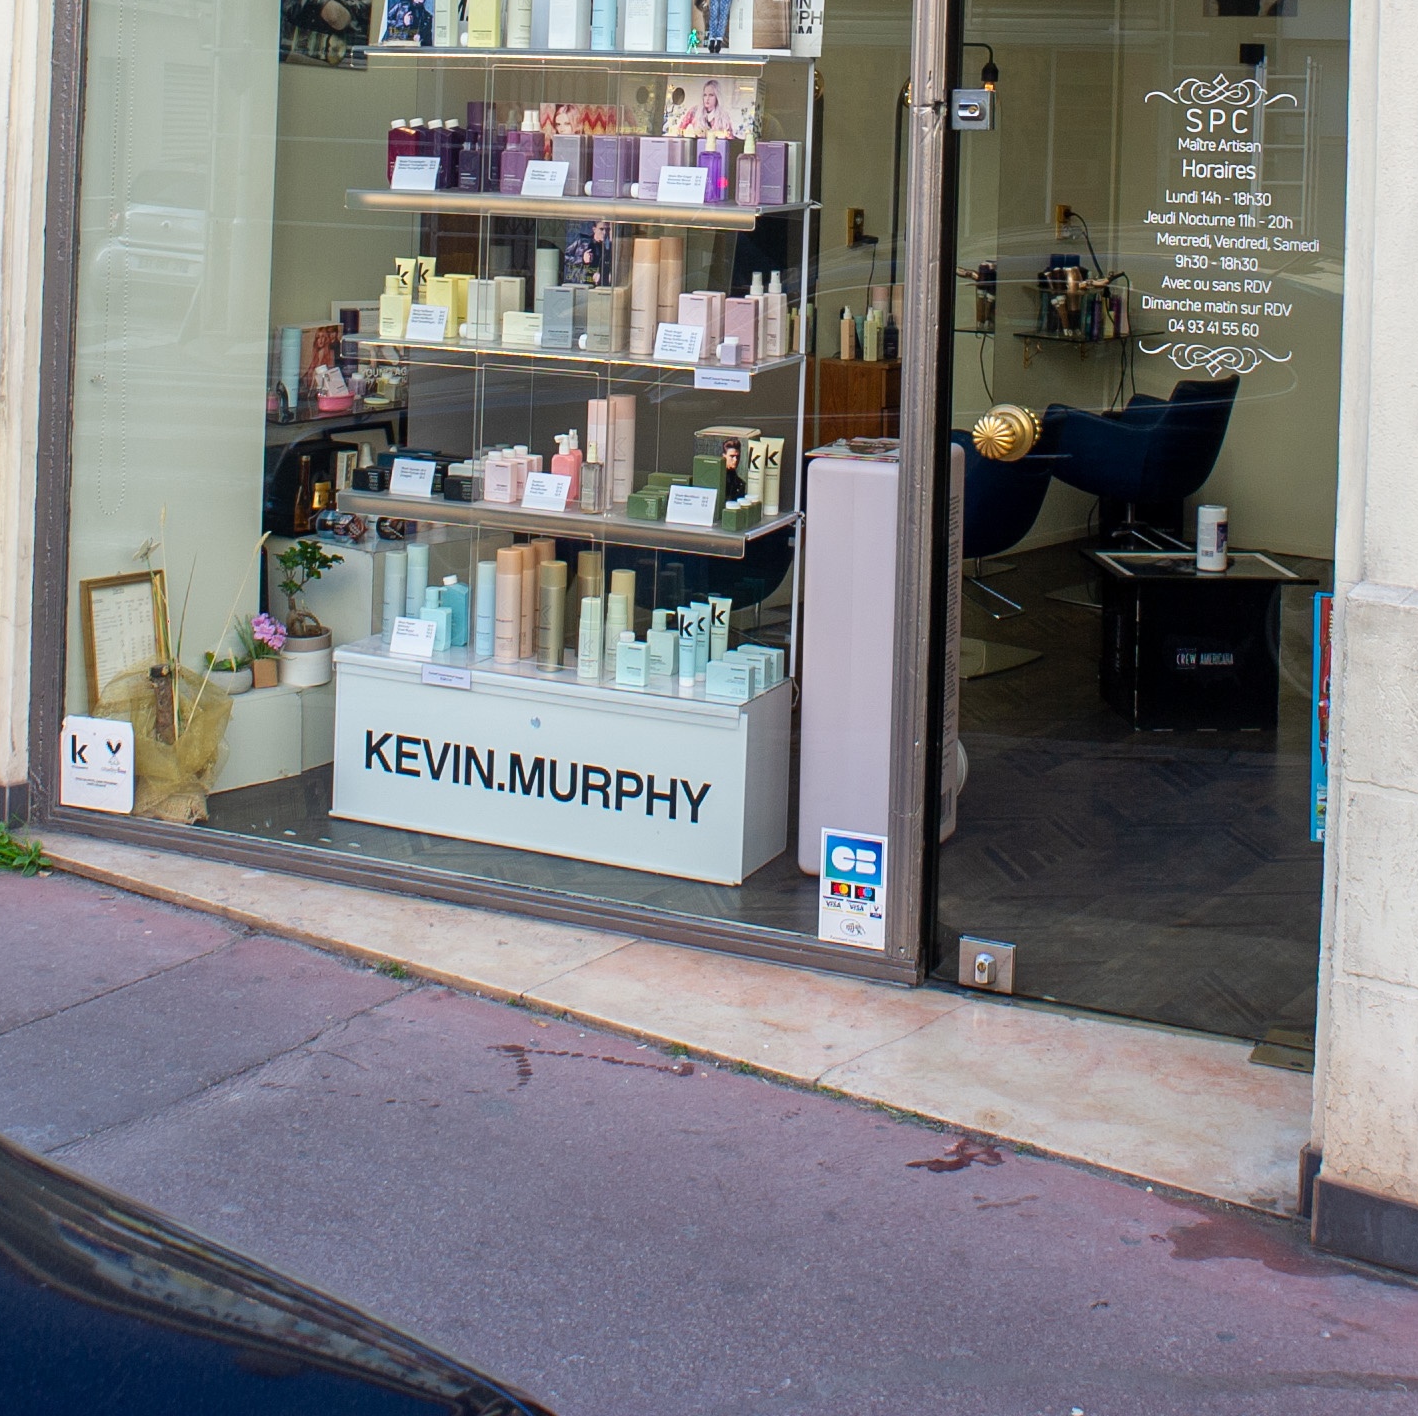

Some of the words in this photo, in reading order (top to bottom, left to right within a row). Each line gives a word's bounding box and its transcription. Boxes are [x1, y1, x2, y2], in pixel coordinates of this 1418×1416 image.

[1186, 108, 1248, 134] SPC
[1178, 137, 1216, 151] Maître
[1218, 139, 1261, 153] Artisan
[1182, 158, 1256, 180] Horaires
[1166, 189, 1198, 204] Lundi
[1200, 191, 1222, 204] 14h
[1233, 192, 1272, 207] 18h30
[1143, 210, 1176, 225] Jeudi
[1179, 212, 1235, 227] Nocturne
[1238, 214, 1256, 228] 11h
[1267, 215, 1293, 229] 20h
[1156, 232, 1212, 249] Mercredi,
[1213, 234, 1271, 251] Vendredi,
[1273, 237, 1320, 252] Samedi
[1175, 254, 1208, 269] 9h30
[1220, 256, 1259, 272] 18h30
[1161, 275, 1192, 290] Avec
[1193, 280, 1210, 291] ou
[1211, 281, 1241, 293] sans
[1244, 280, 1272, 294] RDV
[1142, 296, 1202, 312] Dimanche
[1204, 299, 1238, 314] matin
[1240, 303, 1261, 315] sur
[1264, 302, 1293, 317] RDV
[1168, 318, 1185, 333] 04
[1187, 320, 1204, 335] 93
[1206, 321, 1219, 335] 41
[1221, 322, 1239, 337] 55
[1241, 323, 1260, 338] 60
[365, 729, 712, 824] KEVIN.MURPHY
